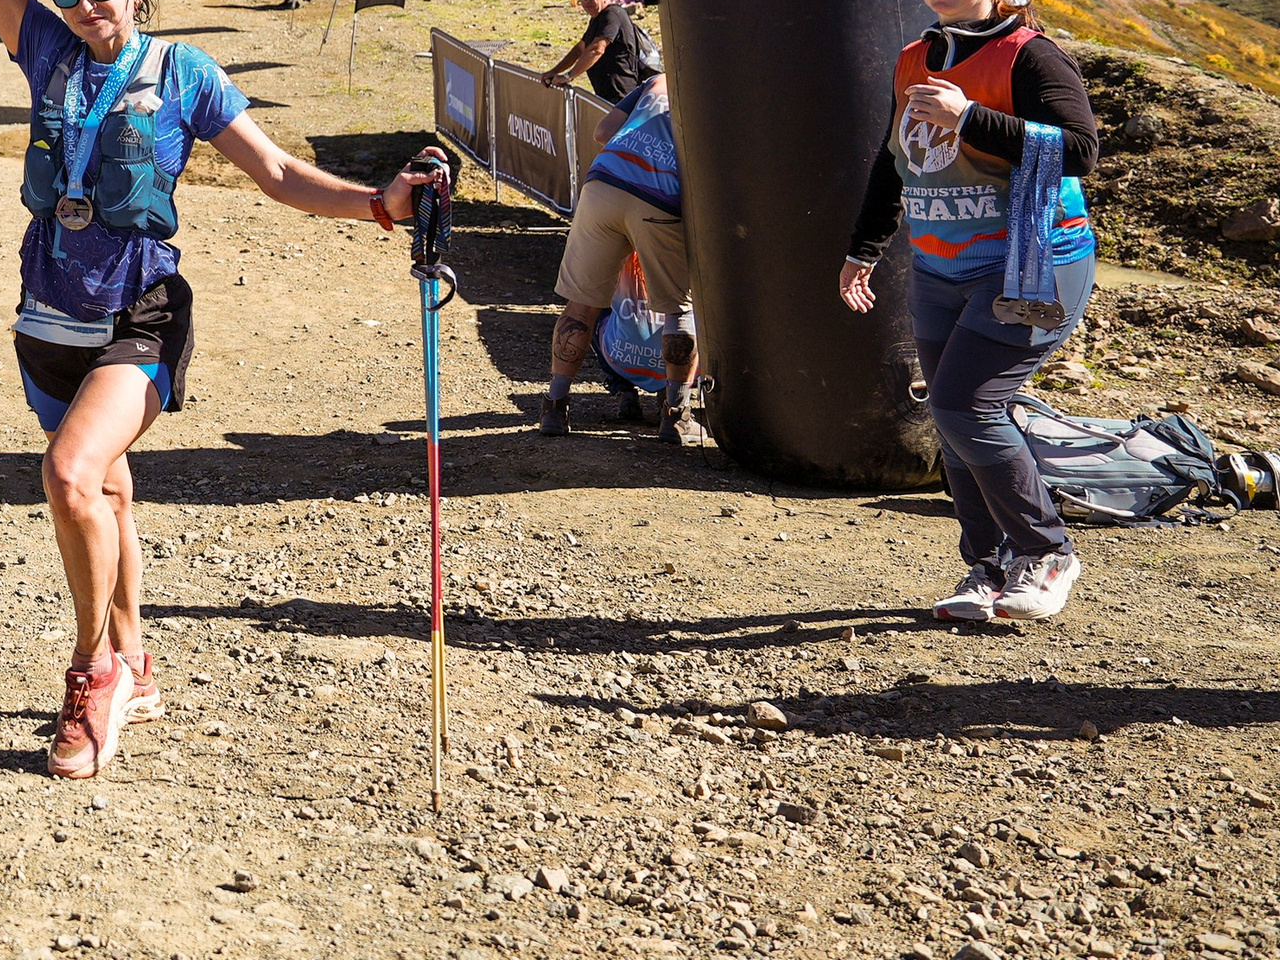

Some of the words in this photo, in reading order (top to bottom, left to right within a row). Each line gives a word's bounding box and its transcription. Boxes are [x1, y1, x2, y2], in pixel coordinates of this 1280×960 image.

[508, 113, 556, 156] ALPINDUSTRIA
[77, 133, 89, 159] SOUTH
[902, 184, 997, 197] PINDUSTRIA
[610, 347, 644, 366] TRAIL
[612, 340, 662, 358] ALPINDU
